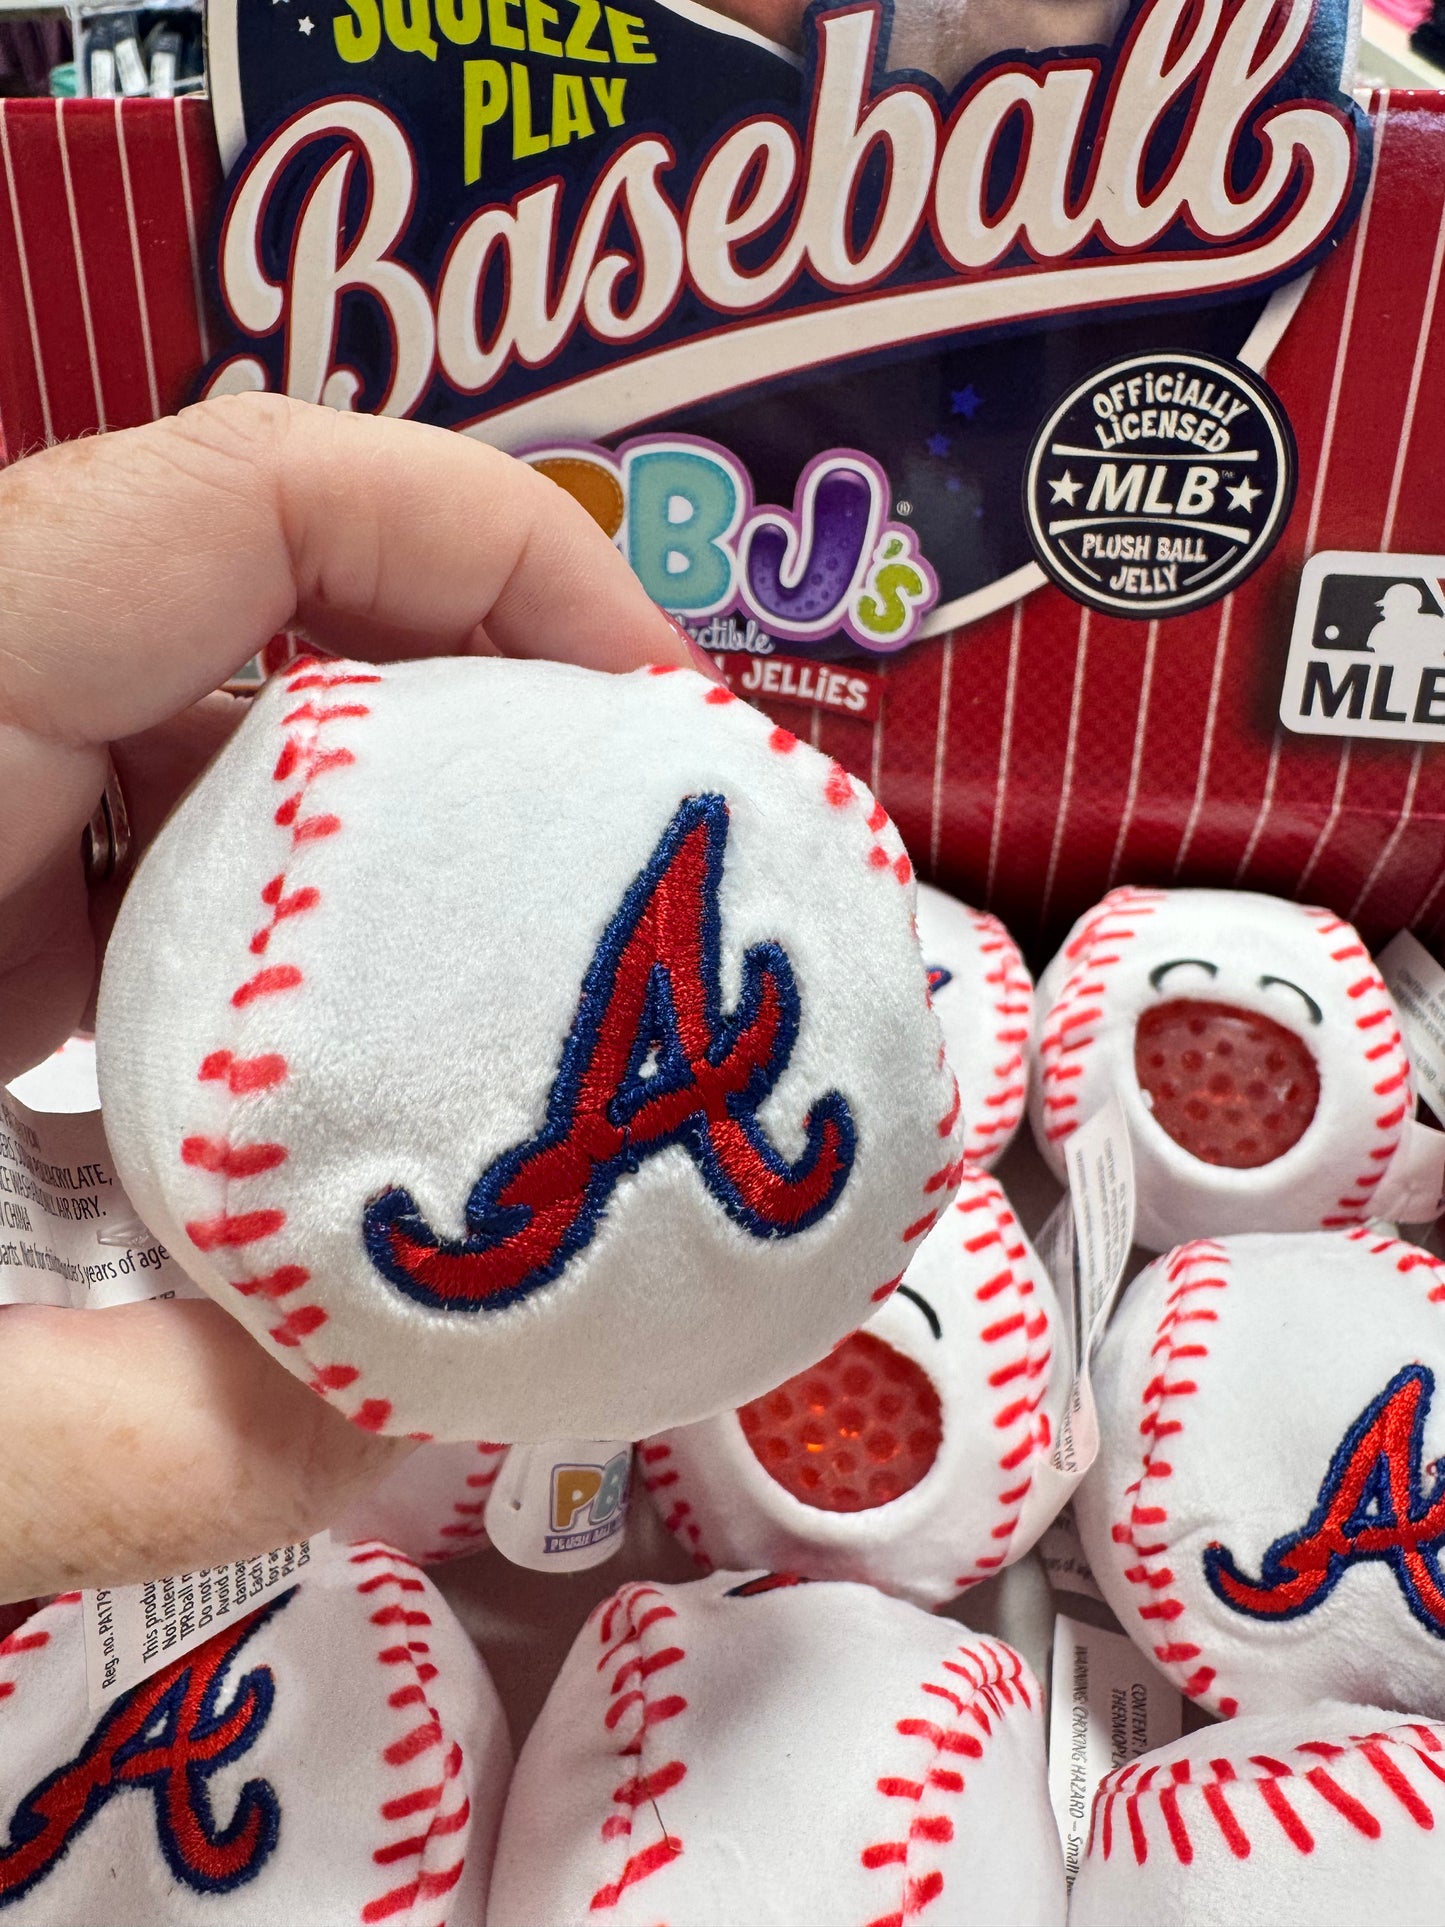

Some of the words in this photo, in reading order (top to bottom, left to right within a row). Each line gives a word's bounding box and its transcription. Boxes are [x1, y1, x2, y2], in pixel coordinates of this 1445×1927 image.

[333, 0, 657, 63] SQUEEZE
[463, 59, 626, 186] PLAY
[217, 0, 1352, 413] Baseball
[1085, 463, 1220, 516] MLB
[1081, 533, 1149, 561] PLUSH
[1156, 535, 1208, 563] BALL
[1109, 563, 1179, 595] JELLY
[675, 614, 776, 654] ctible
[83, 1262, 118, 1289] years
[119, 1249, 136, 1275] of
[137, 1244, 170, 1269] age
[552, 1451, 629, 1532] PB
[198, 1577, 212, 1603] not
[214, 1576, 230, 1615] Avoid
[248, 1562, 263, 1597] Each
[96, 1588, 114, 1635] PA179
[178, 1584, 194, 1615] ball
[198, 1604, 213, 1628] Do
[103, 1632, 115, 1656] no.
[162, 1620, 177, 1650] Not
[180, 1610, 195, 1640] TPR
[142, 1628, 158, 1663] This
[102, 1655, 120, 1689] Reg.
[1071, 1706, 1089, 1763] CHOKING
[1131, 1683, 1147, 1747] CONTENT:
[1069, 1764, 1087, 1819] HAZARD
[1065, 1834, 1083, 1874] Small
